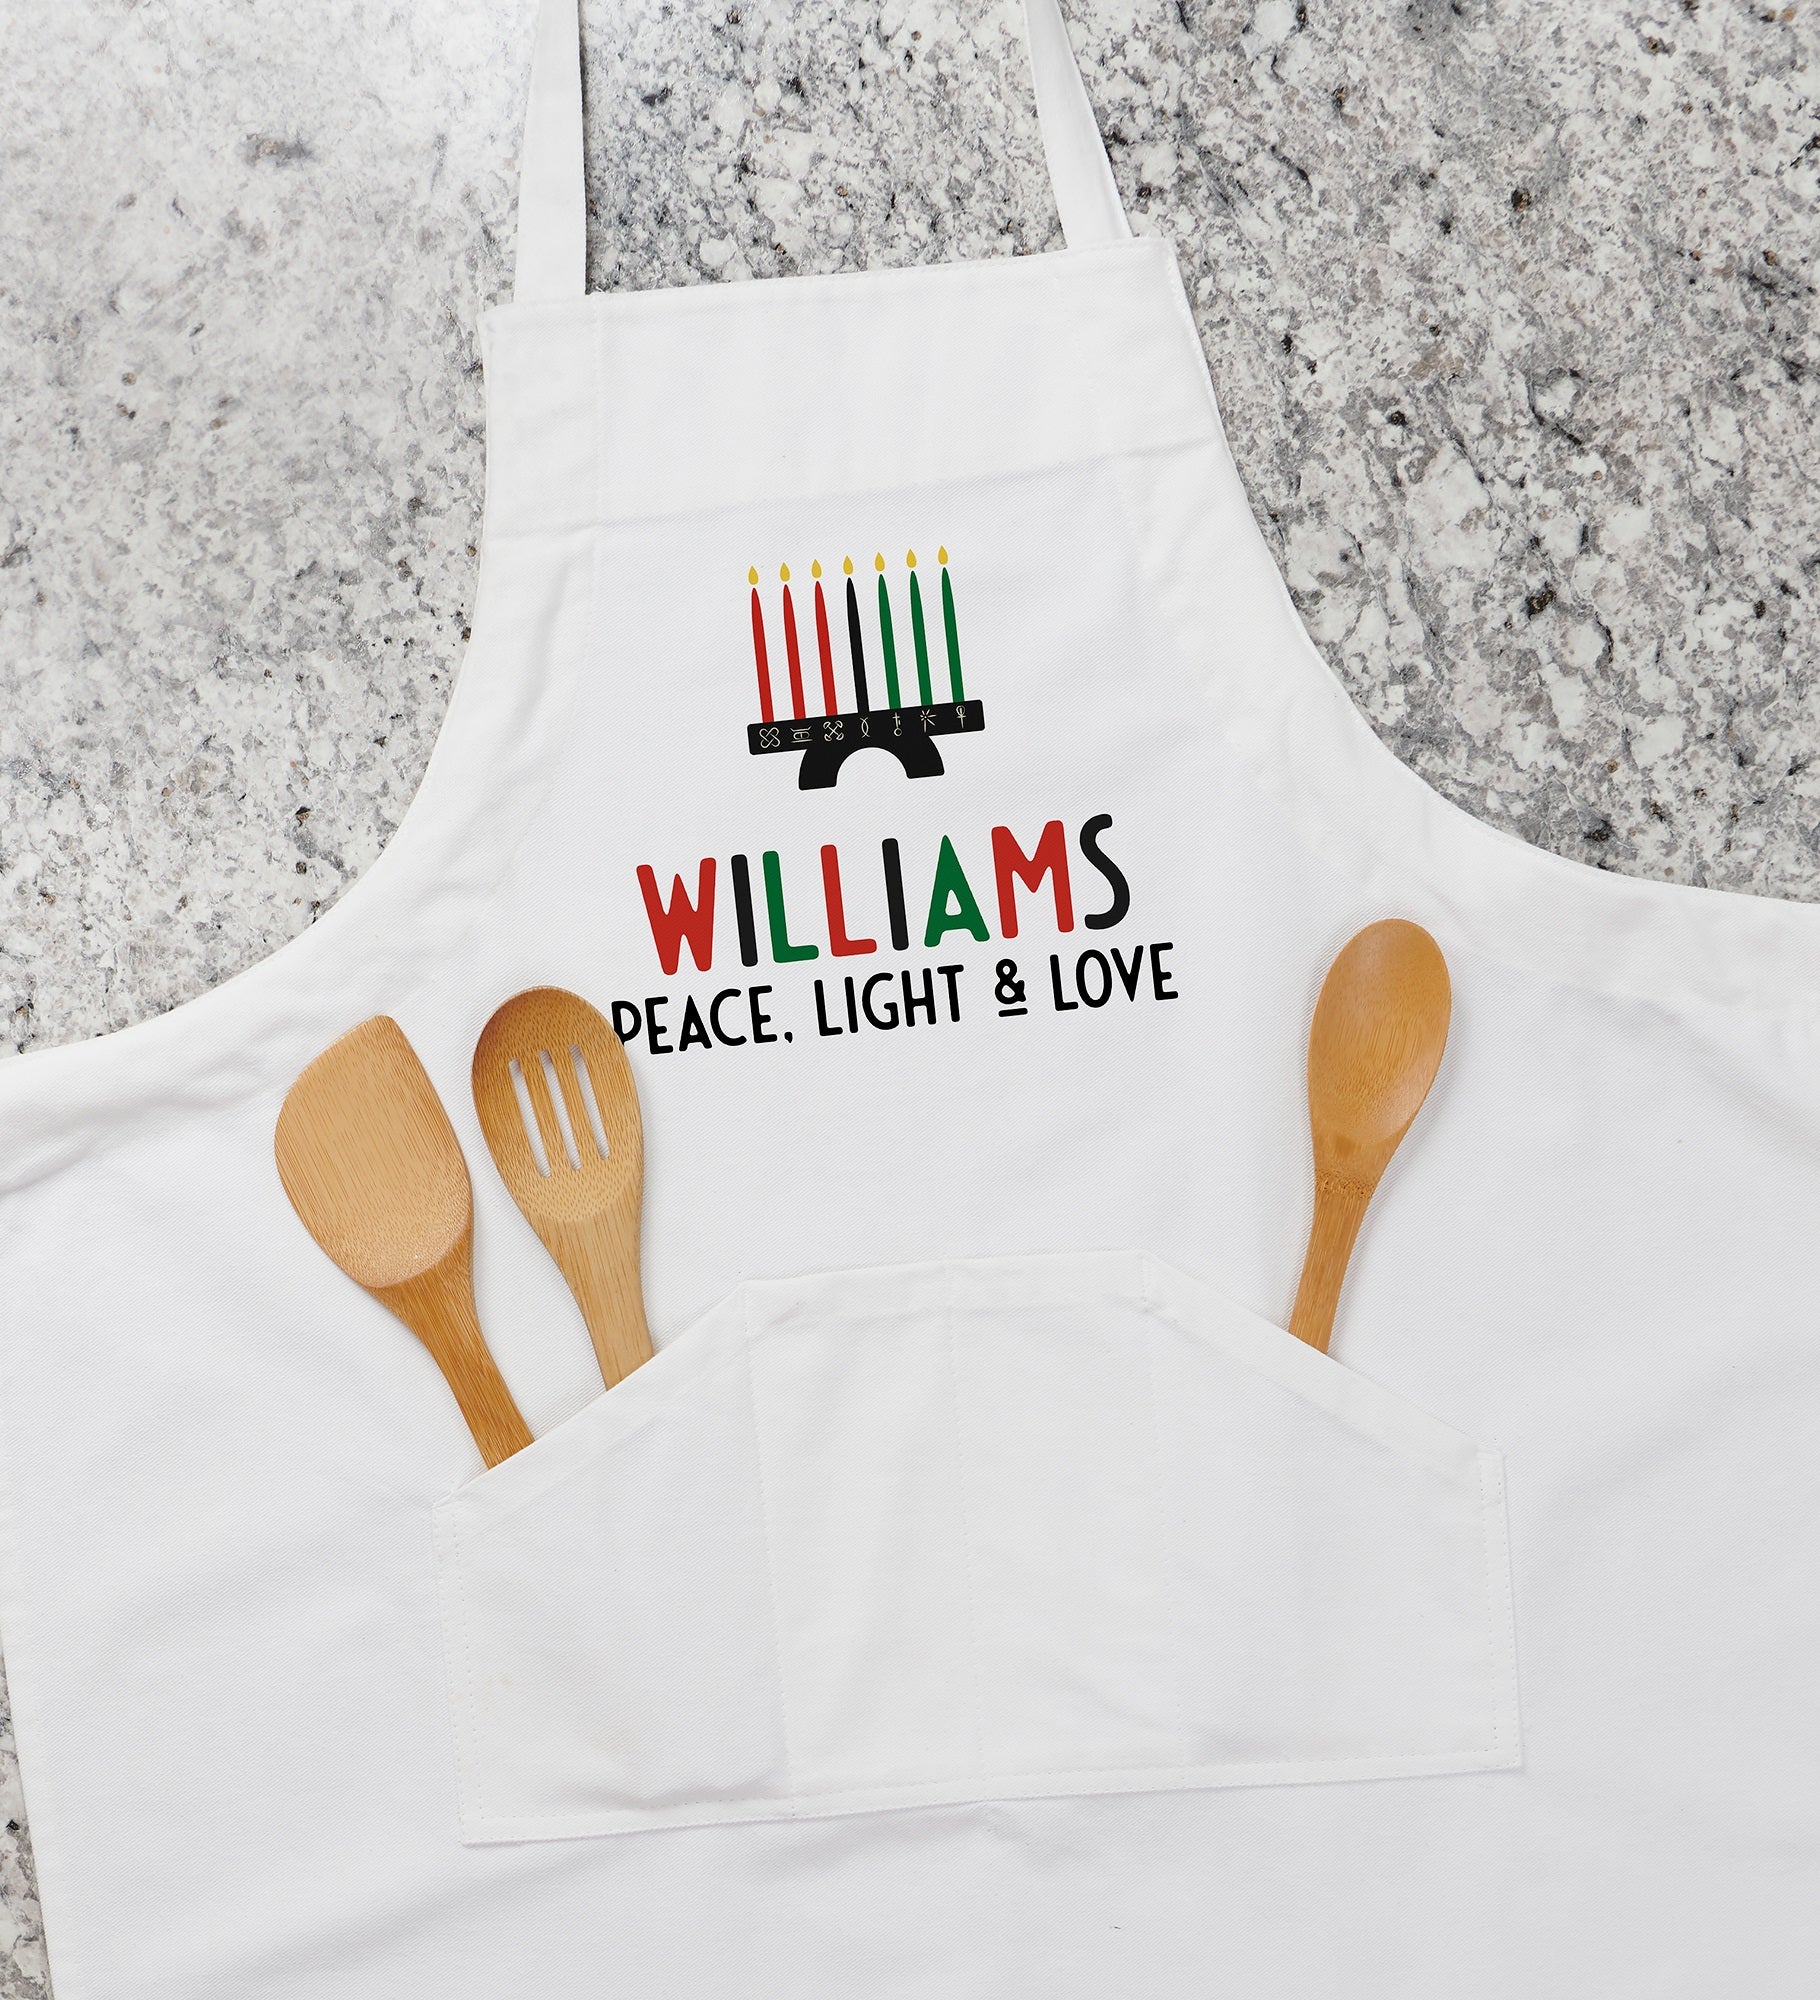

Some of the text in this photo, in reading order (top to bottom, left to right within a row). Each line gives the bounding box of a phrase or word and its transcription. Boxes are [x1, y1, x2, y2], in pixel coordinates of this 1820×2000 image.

[636, 813, 1131, 976] WILLIAMS
[611, 941, 1179, 1055] PEACE, LIGHT & LOVE
